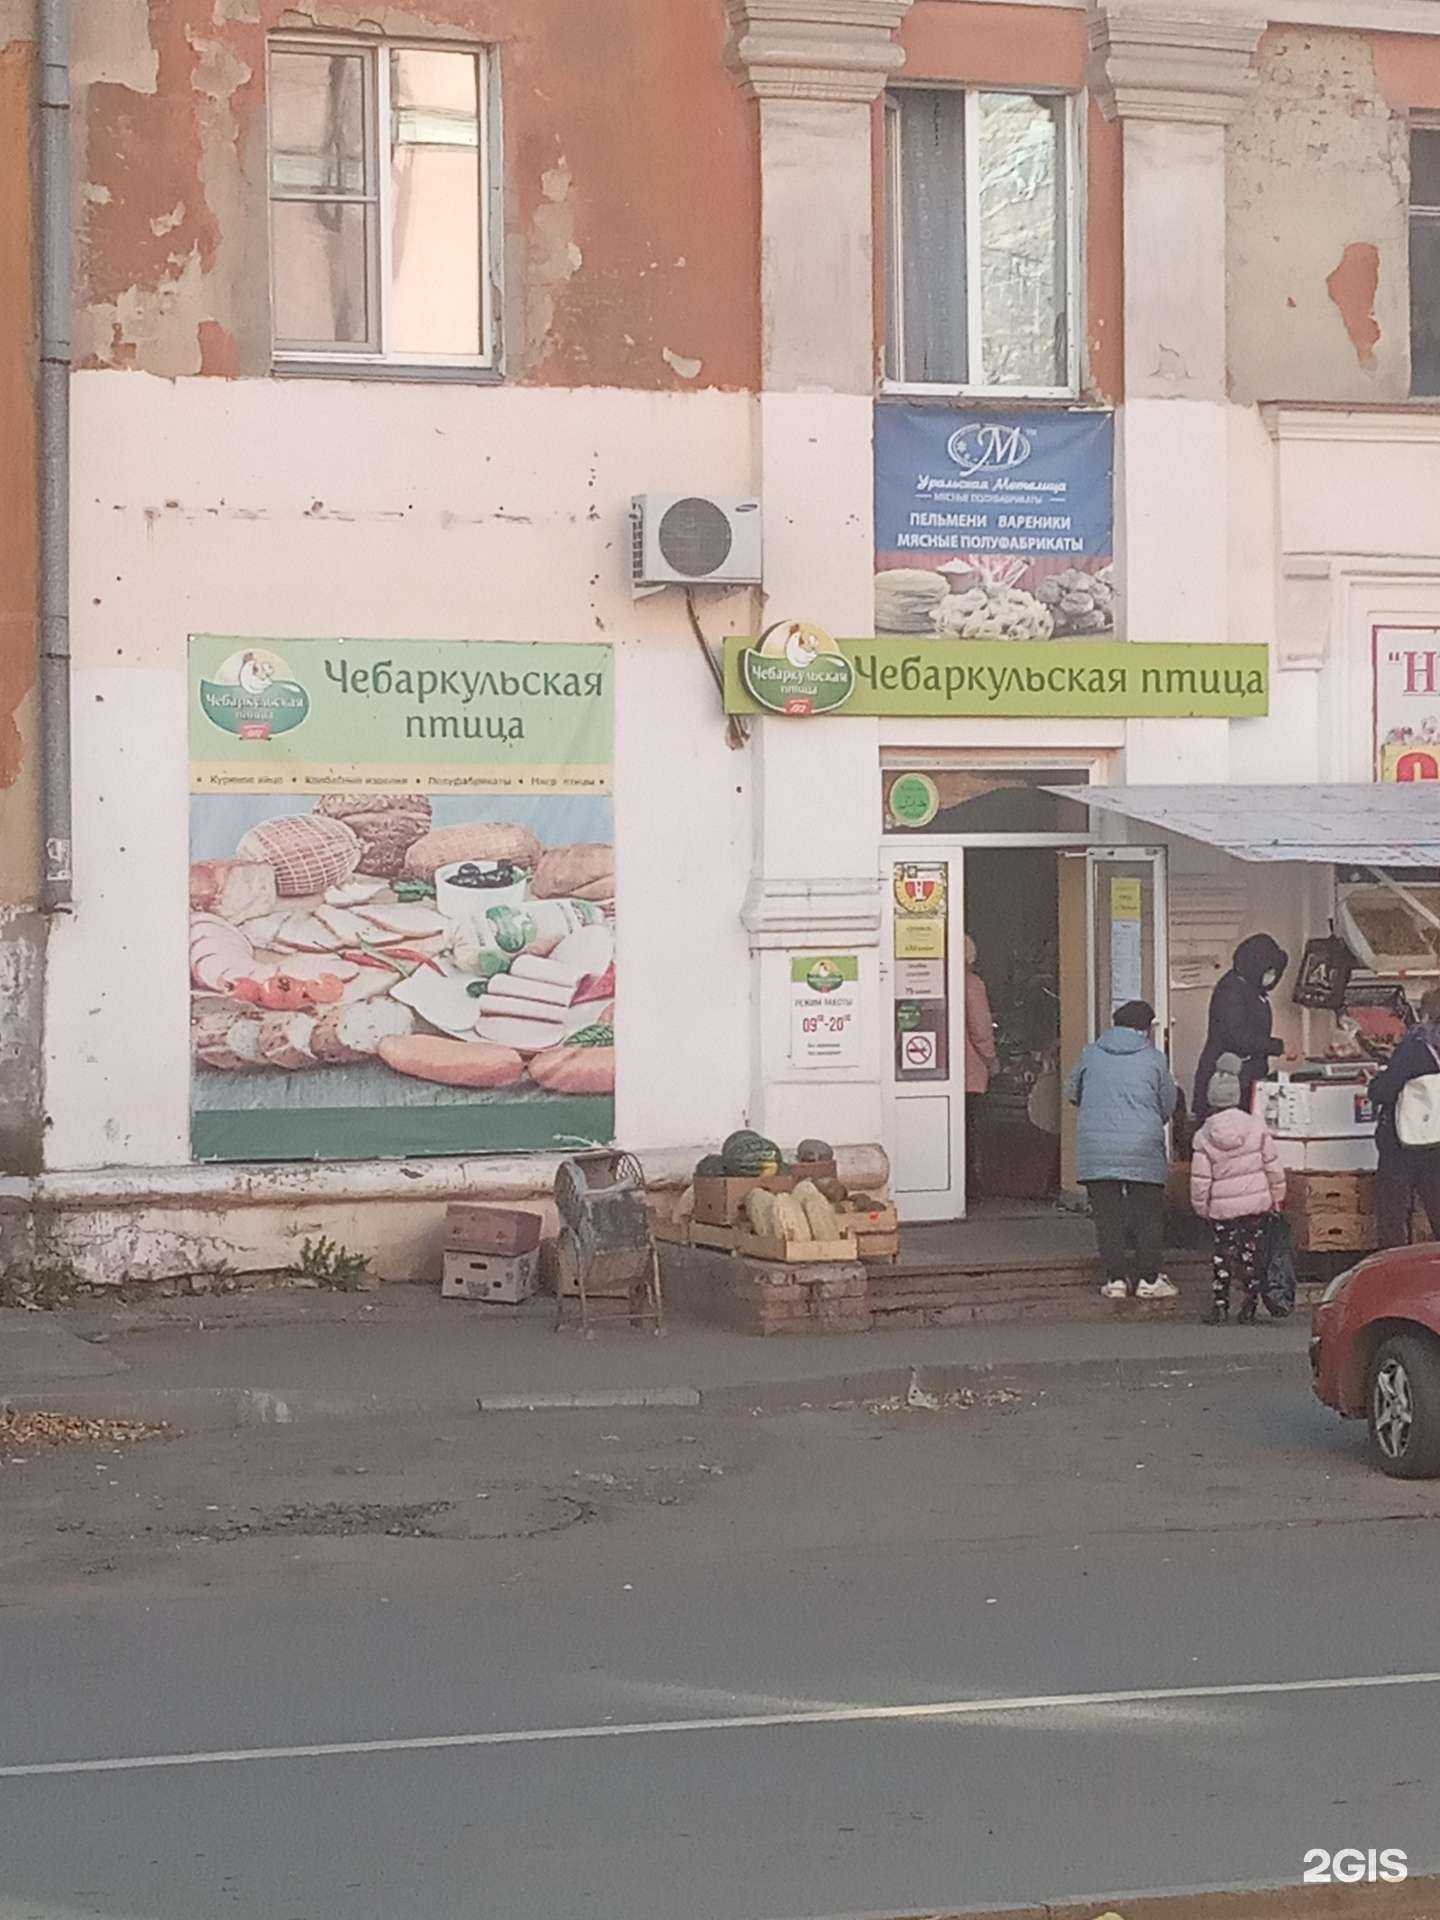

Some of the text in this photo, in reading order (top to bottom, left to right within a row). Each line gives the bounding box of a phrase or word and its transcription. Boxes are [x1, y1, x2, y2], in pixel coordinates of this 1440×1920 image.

[910, 512, 1071, 530] ПЕЛЬМЕНИ ВАРЕНИКИ
[897, 533, 1084, 552] МЯСНЫЕ ПОЛУФАБРИКАТЫ
[324, 659, 604, 704] Чебаркульская
[752, 664, 848, 683] Чебаркульская
[854, 654, 1265, 701] Чебаркульская птица
[405, 713, 525, 743] птица
